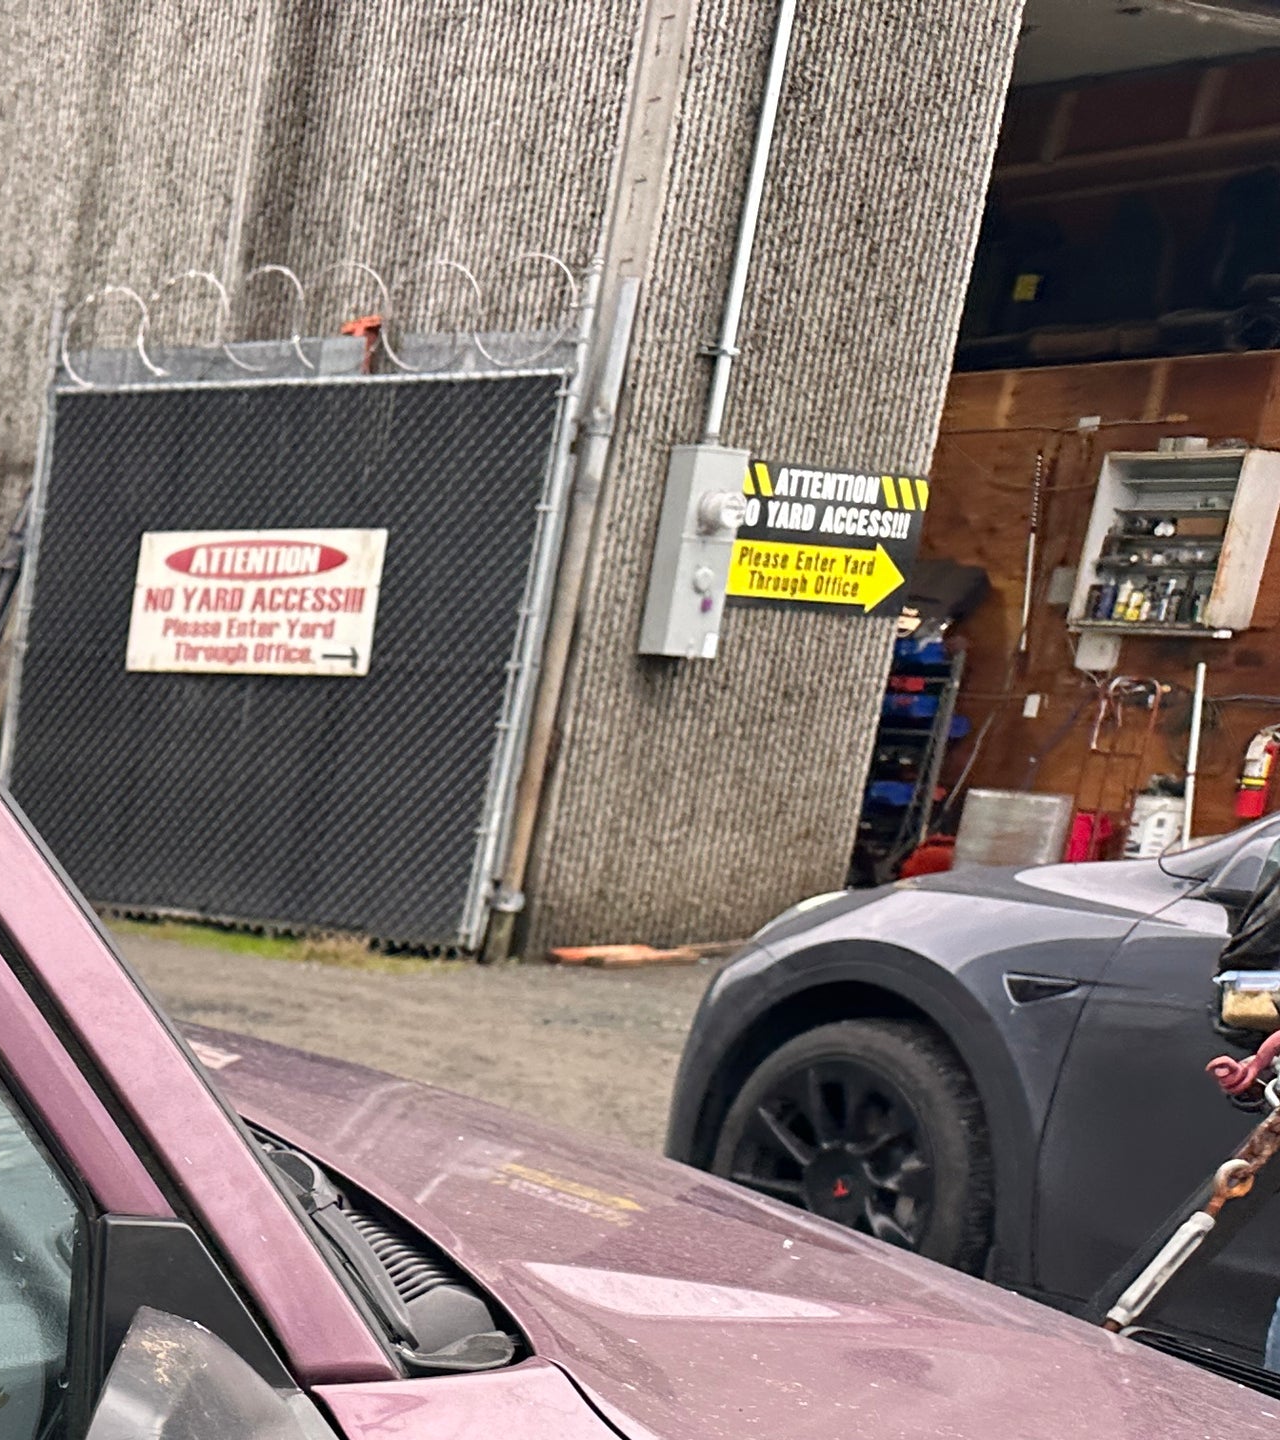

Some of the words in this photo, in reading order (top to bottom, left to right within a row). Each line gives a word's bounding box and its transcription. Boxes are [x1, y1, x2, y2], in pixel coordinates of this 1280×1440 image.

[775, 467, 880, 504] ATTENTION
[744, 498, 761, 527] O
[766, 500, 816, 531] YARD
[819, 505, 911, 539] ACCESS!!!
[189, 545, 321, 574] ATTENTION
[738, 546, 790, 571] Please
[795, 550, 837, 574] Enter
[843, 554, 876, 577] Yard
[748, 570, 808, 598] Through
[814, 575, 859, 597] Office
[144, 587, 175, 613] NO
[183, 587, 244, 613] YARD
[162, 618, 221, 638] Please
[226, 618, 280, 638] Enter
[287, 618, 336, 639] Yard
[174, 641, 249, 665] Through
